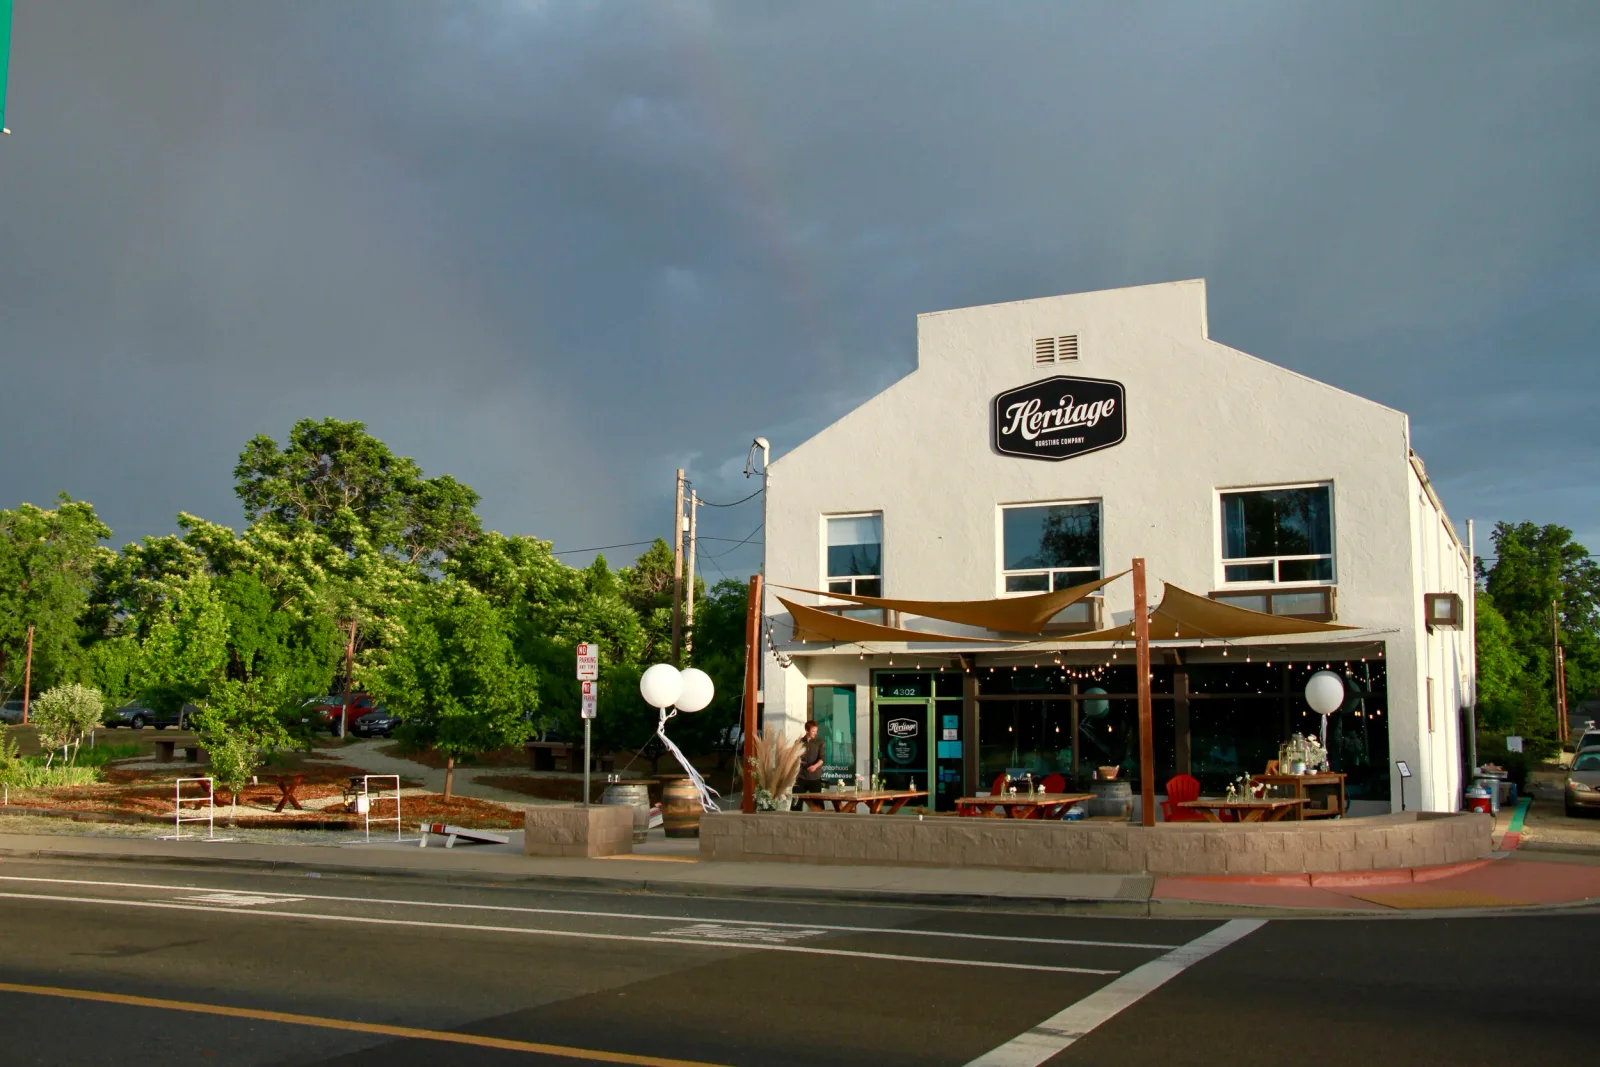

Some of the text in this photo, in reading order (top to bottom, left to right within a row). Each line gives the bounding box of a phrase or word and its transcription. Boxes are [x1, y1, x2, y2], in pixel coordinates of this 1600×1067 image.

[1002, 394, 1115, 440] Heritage
[1035, 436, 1084, 447] ROASTING COMPANY
[578, 646, 586, 654] NO
[893, 688, 916, 696] 4302
